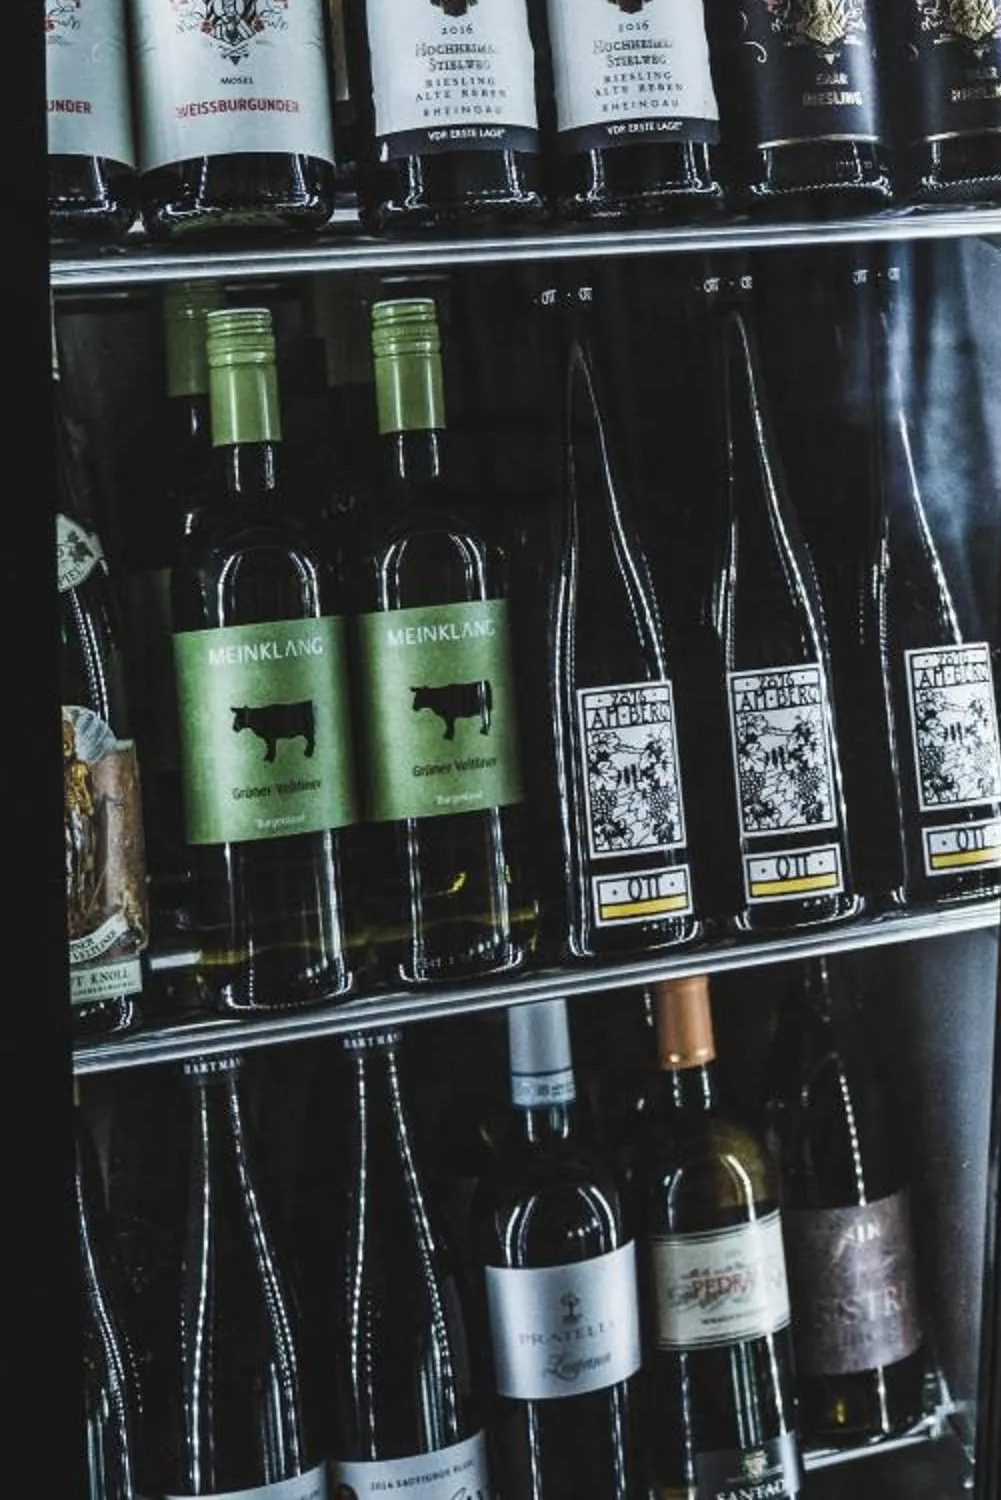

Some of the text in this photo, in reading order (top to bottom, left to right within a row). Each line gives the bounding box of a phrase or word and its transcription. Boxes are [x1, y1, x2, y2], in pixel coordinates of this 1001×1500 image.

[175, 97, 301, 119] WEISSBURGUNDER
[387, 619, 496, 646] MEINKLANG
[208, 636, 324, 665] MEINKLANG
[955, 827, 986, 851] OTT
[776, 854, 811, 880] OTT
[628, 876, 664, 902] OTT
